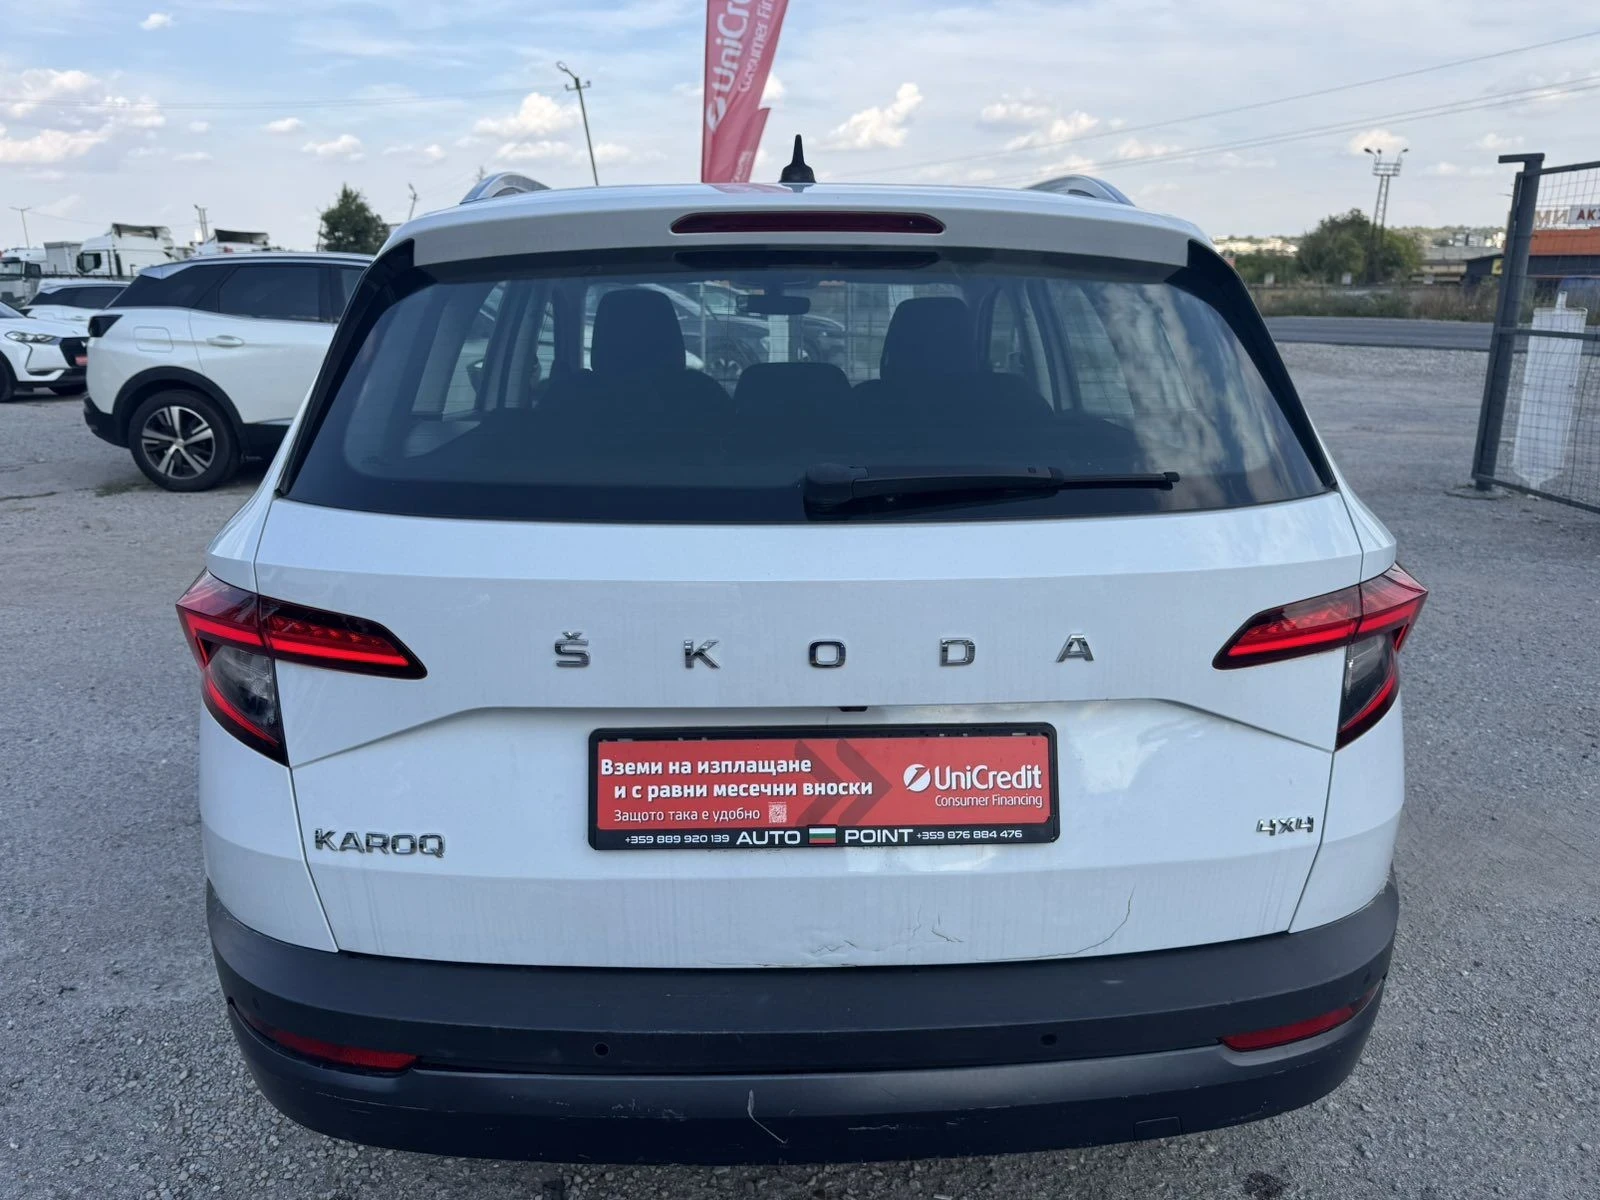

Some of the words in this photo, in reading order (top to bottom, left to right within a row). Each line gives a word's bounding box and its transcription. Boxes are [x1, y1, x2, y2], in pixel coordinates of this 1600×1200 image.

[711, 0, 752, 93] UniCr
[1576, 208, 1600, 221] АК
[554, 631, 1094, 669] ŠKODA
[600, 758, 664, 776] Вземи
[668, 760, 692, 774] на
[697, 759, 812, 776] изплащане
[934, 764, 1042, 790] UniCredit
[614, 785, 627, 799] и
[631, 785, 643, 799] с
[647, 784, 708, 802] равни
[713, 782, 798, 797] месечни
[802, 782, 873, 796] вноски
[935, 794, 989, 807] Consumer
[991, 793, 1043, 808] Financing
[613, 809, 665, 823] Защото
[668, 810, 699, 821] така
[701, 810, 709, 821] е
[712, 807, 761, 822] удобно
[314, 827, 446, 858] KAROQ
[624, 835, 654, 844] +359
[656, 834, 681, 844] 889
[683, 834, 708, 843] 920
[711, 834, 730, 843] 139
[735, 830, 801, 845] AUTO
[844, 828, 914, 844] POINT
[916, 831, 945, 840] +359
[947, 831, 971, 840] 876
[973, 830, 997, 840] 884
[999, 829, 1023, 839] 476
